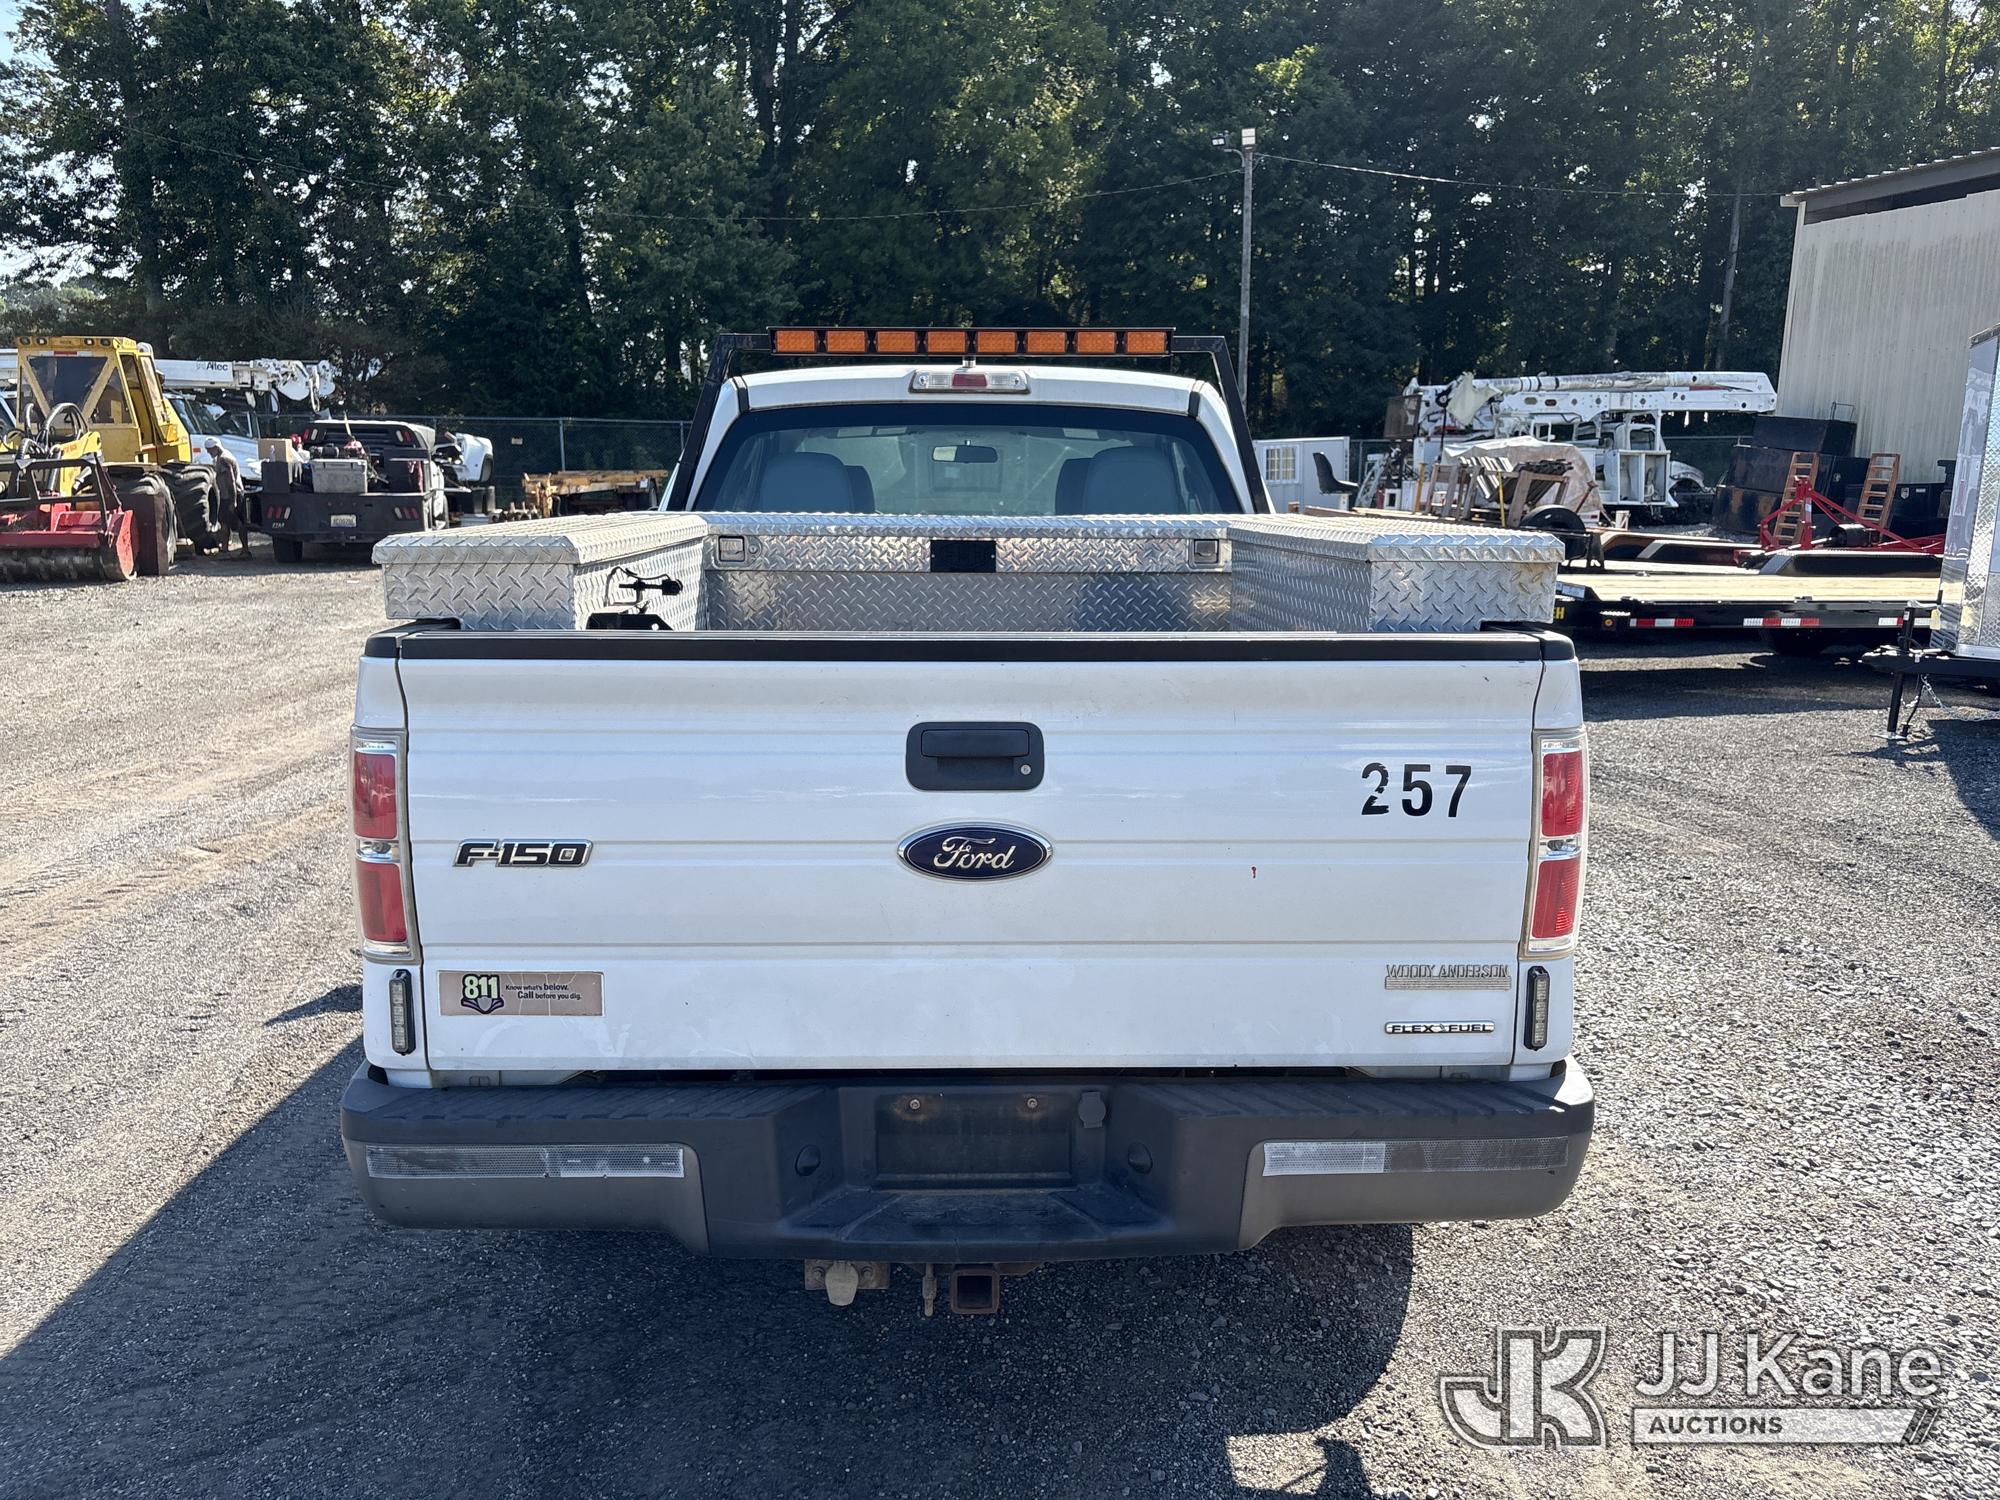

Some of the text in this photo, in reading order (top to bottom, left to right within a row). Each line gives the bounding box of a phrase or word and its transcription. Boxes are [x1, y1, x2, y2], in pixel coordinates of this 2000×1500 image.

[1361, 762, 1471, 817] 257
[453, 839, 594, 867] F-150
[933, 836, 1017, 869] Ford
[1386, 964, 1509, 978] WOODY ANDERSON
[463, 974, 499, 999] 811
[517, 990, 582, 1001] Call before you dig.
[544, 983, 569, 991] below.
[1391, 1024, 1493, 1033] FLEX FUEL
